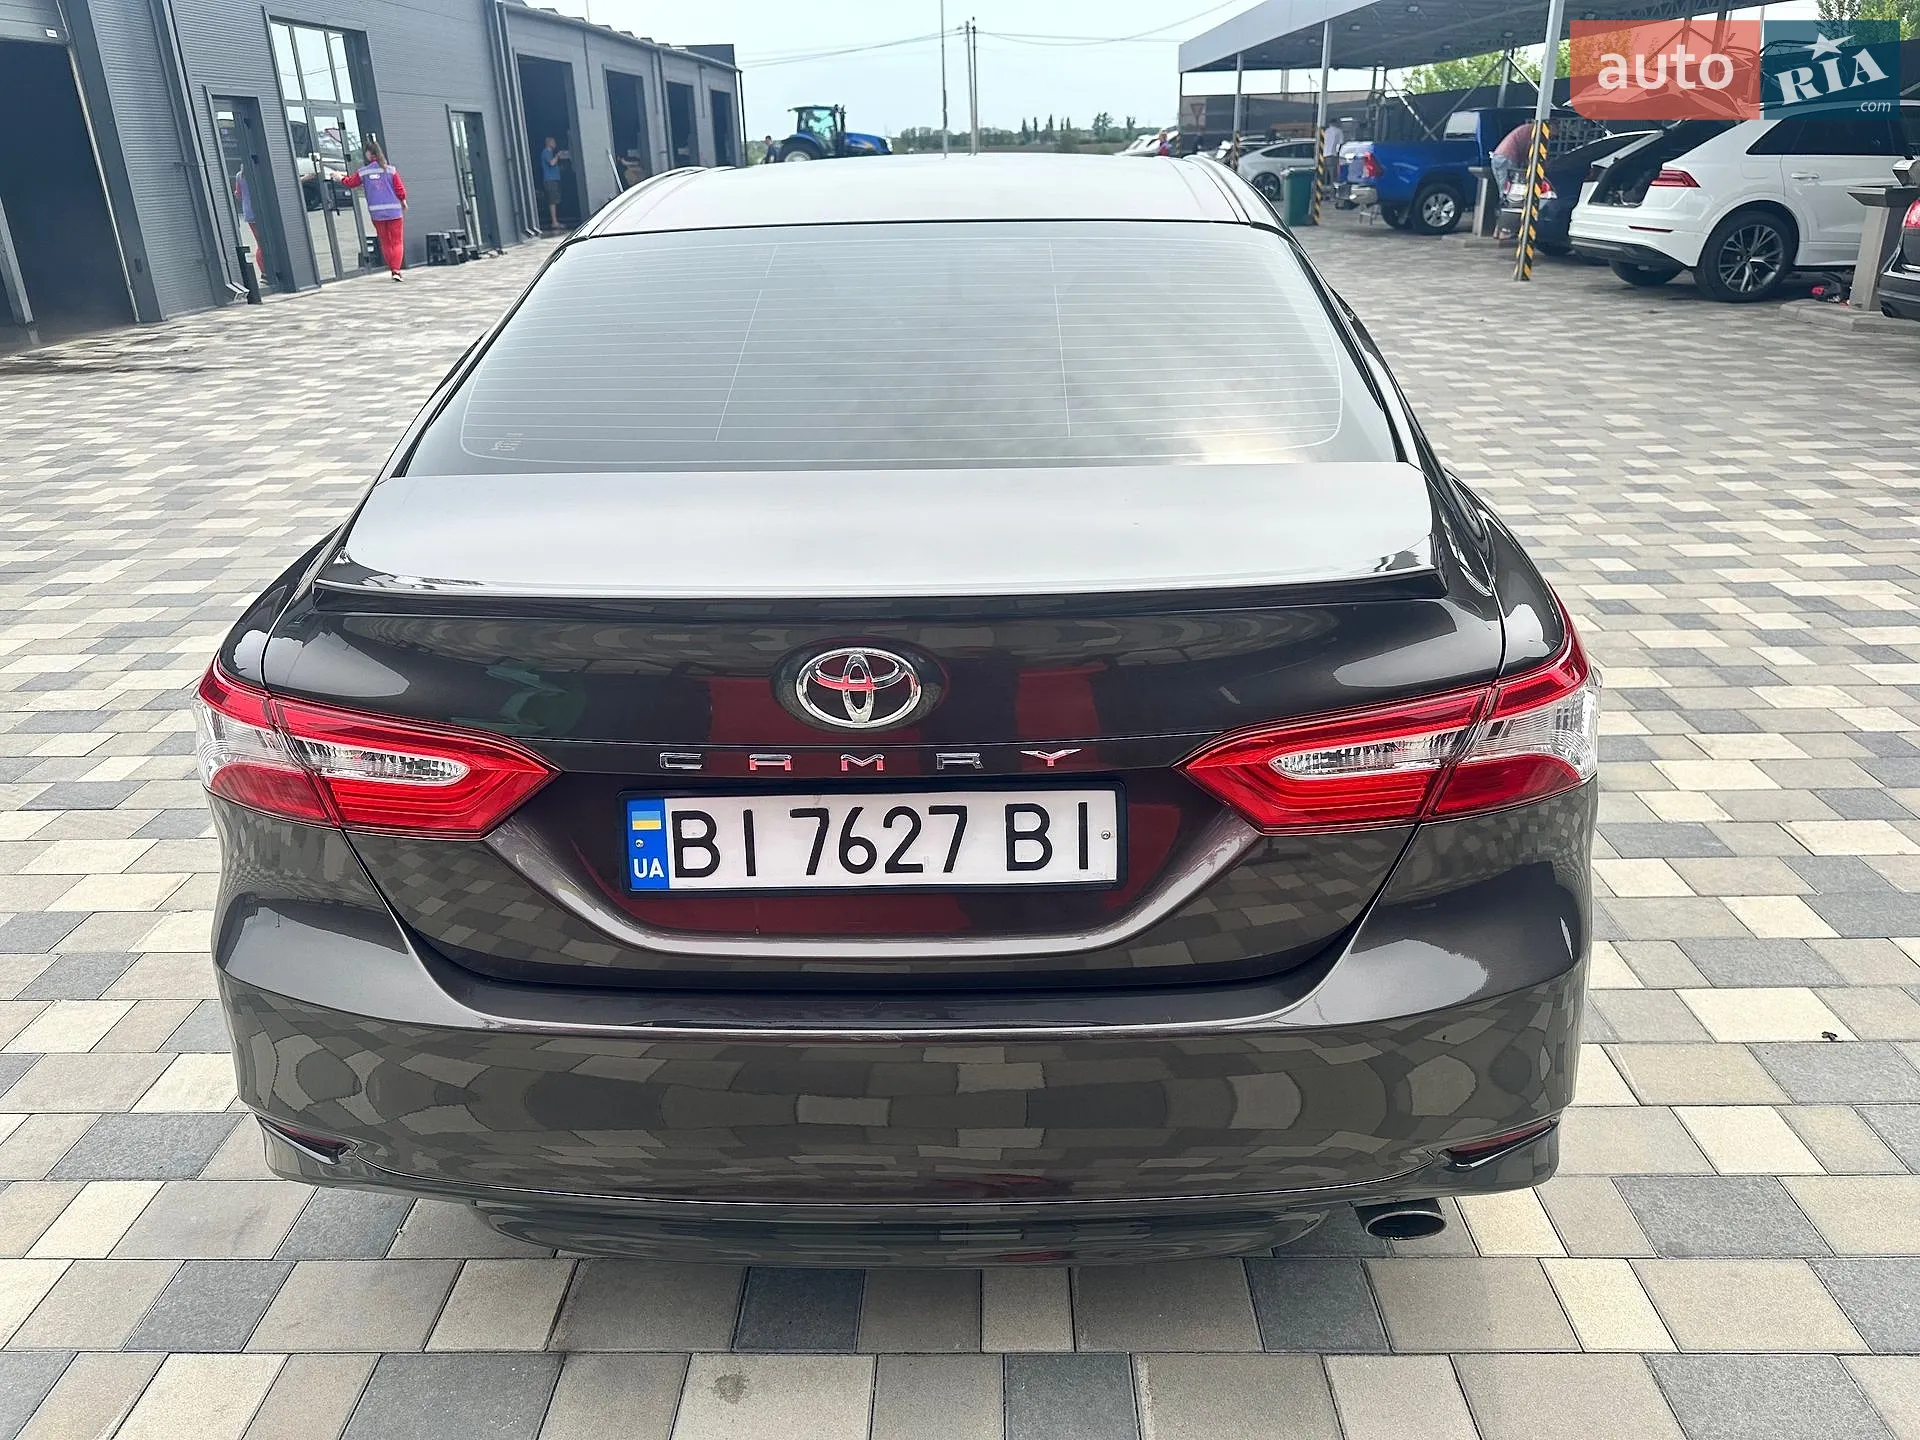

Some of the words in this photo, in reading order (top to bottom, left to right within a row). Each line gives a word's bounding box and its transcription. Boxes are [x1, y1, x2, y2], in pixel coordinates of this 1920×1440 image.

[659, 749, 1082, 771] CAMRY
[671, 810, 757, 878] BI
[790, 805, 968, 876] 7627
[1004, 802, 1089, 872] BI
[633, 858, 665, 878] UA
